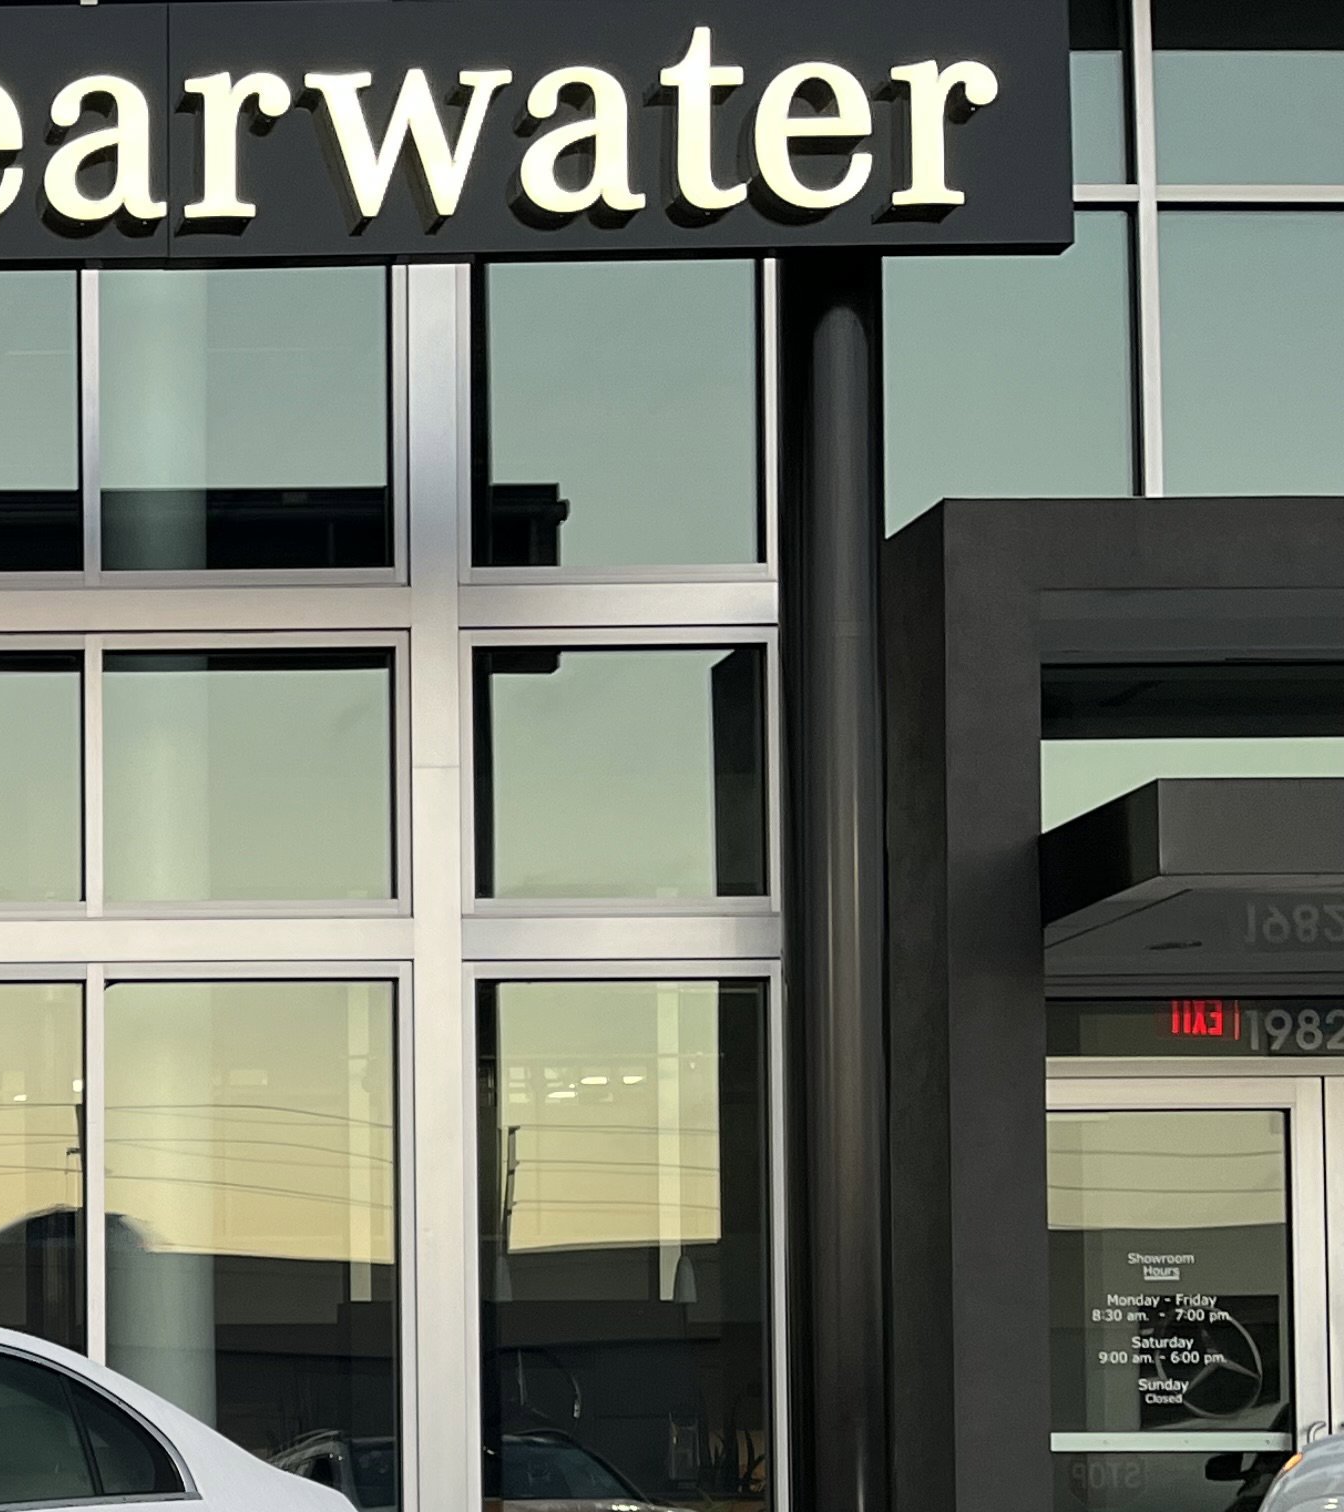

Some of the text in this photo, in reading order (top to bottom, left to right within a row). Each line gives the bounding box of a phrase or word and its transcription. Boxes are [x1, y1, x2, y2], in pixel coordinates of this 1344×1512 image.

[1127, 1252, 1195, 1265] Showroom
[1143, 1265, 1180, 1278] Hours
[1107, 1294, 1160, 1308] Monday
[1175, 1293, 1217, 1308] Friday
[1092, 1309, 1122, 1321] 8:30
[1175, 1309, 1205, 1321] 7:00
[1131, 1336, 1194, 1350] Saturday
[1098, 1351, 1128, 1364] 9:00
[1170, 1351, 1200, 1364] 6:00
[1138, 1378, 1189, 1394] Sunday
[1144, 1393, 1183, 1404] Closed
